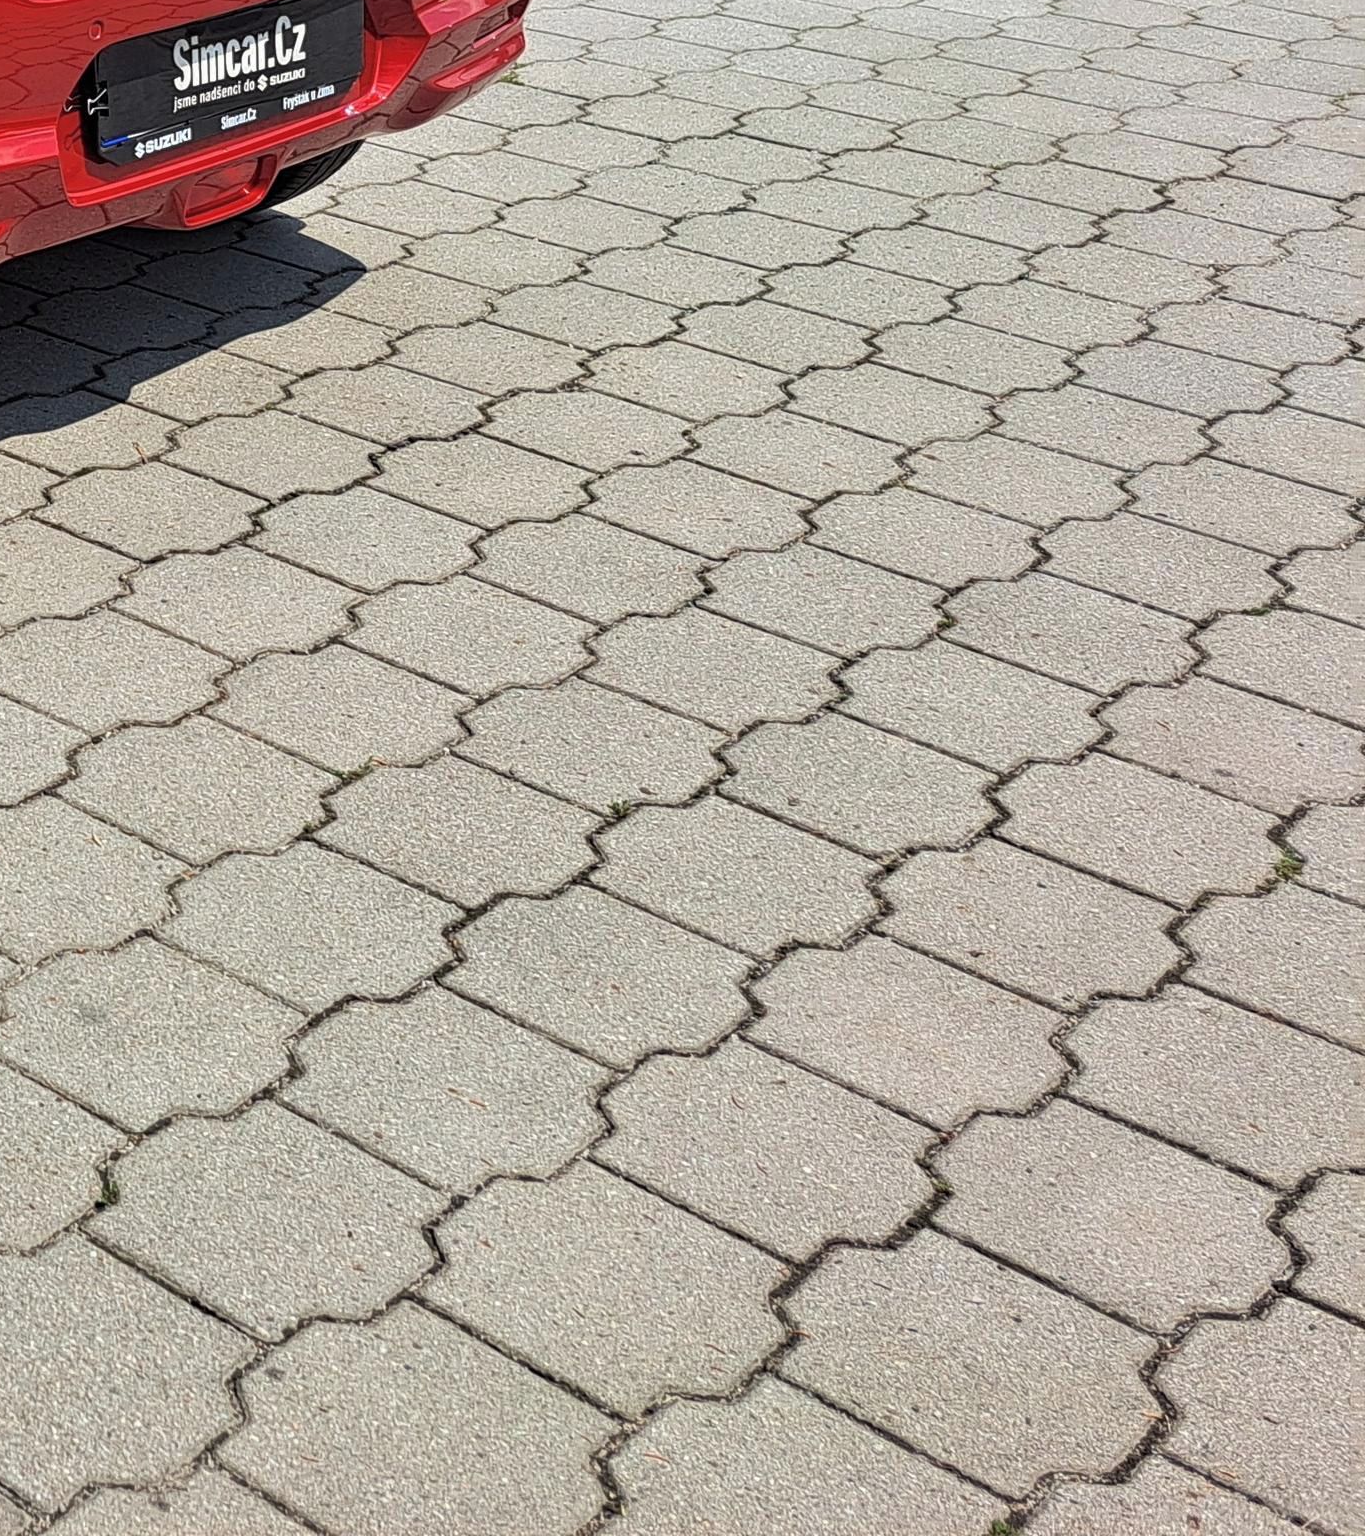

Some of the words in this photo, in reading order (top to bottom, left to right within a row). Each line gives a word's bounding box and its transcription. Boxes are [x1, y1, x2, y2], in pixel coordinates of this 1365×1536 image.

[173, 15, 306, 91] Simcar.Cz
[173, 96, 197, 113] jsme
[200, 81, 242, 104] nadšenci
[244, 79, 255, 93] do
[270, 68, 306, 86] SUZUKI
[145, 128, 192, 154] SUZUKI
[221, 108, 257, 130] Simcar.Cz
